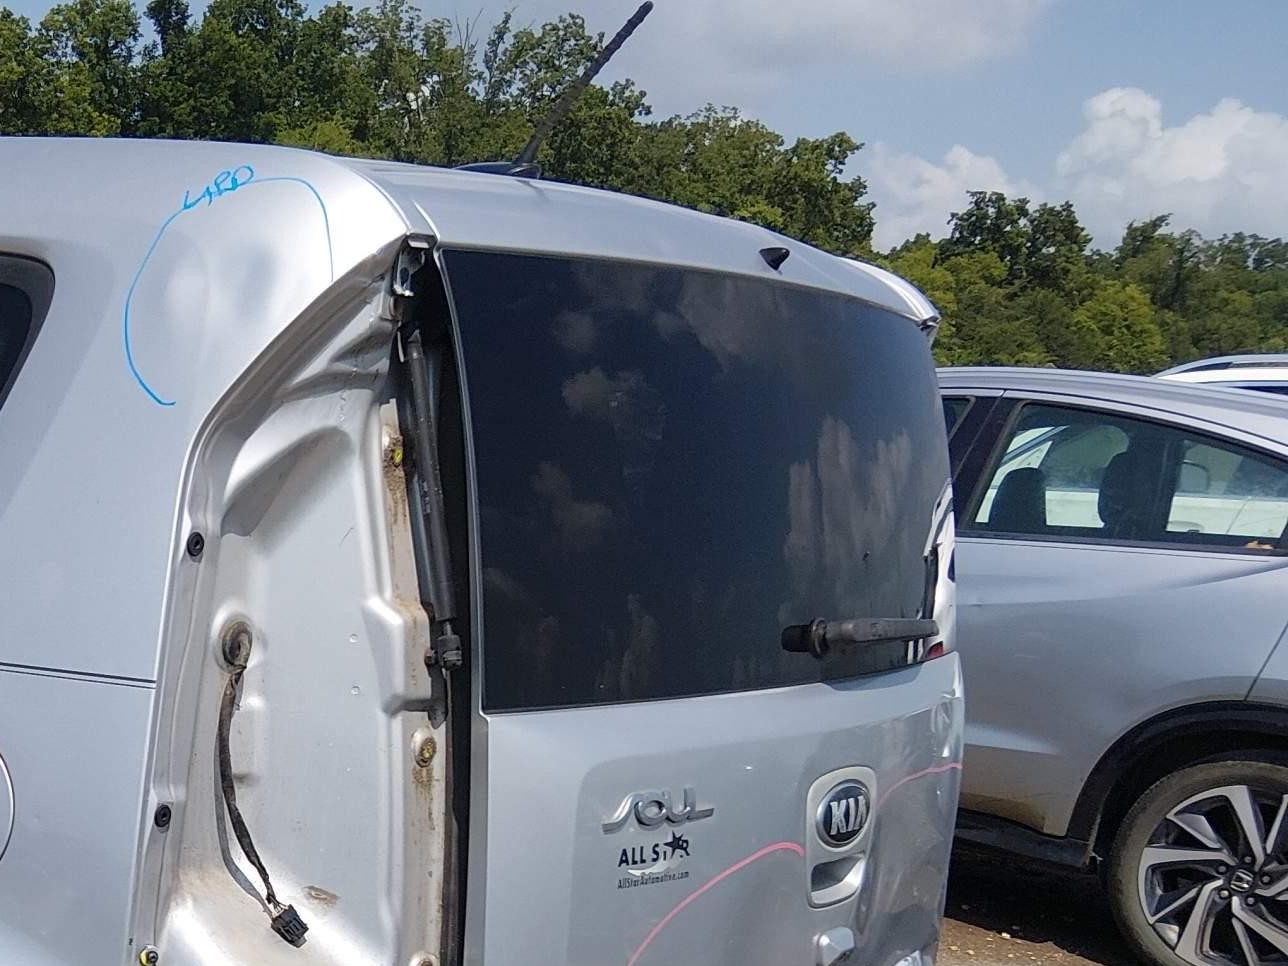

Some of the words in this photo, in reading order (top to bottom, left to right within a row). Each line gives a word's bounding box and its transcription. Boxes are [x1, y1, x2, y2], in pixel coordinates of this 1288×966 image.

[601, 786, 715, 835] SOUL
[829, 795, 867, 835] KIA
[617, 845, 647, 868] ALL
